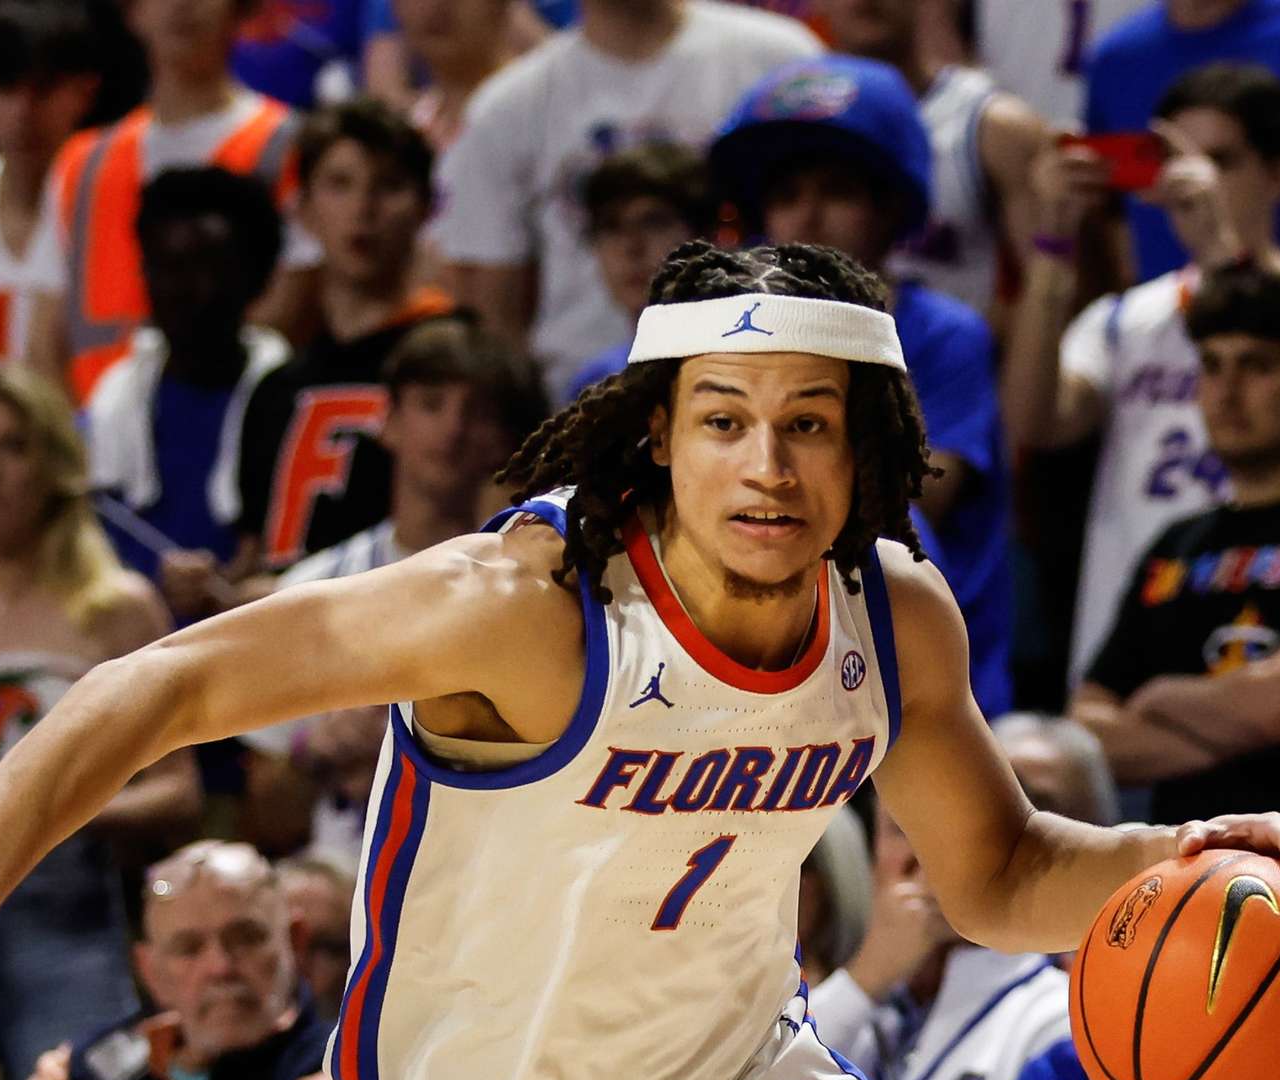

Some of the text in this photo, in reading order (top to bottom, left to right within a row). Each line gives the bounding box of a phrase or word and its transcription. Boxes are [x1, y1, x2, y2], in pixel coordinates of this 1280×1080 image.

[266, 382, 390, 564] F
[842, 653, 864, 689] SEC
[573, 734, 876, 816] FLORIDA
[650, 834, 738, 932] 1
